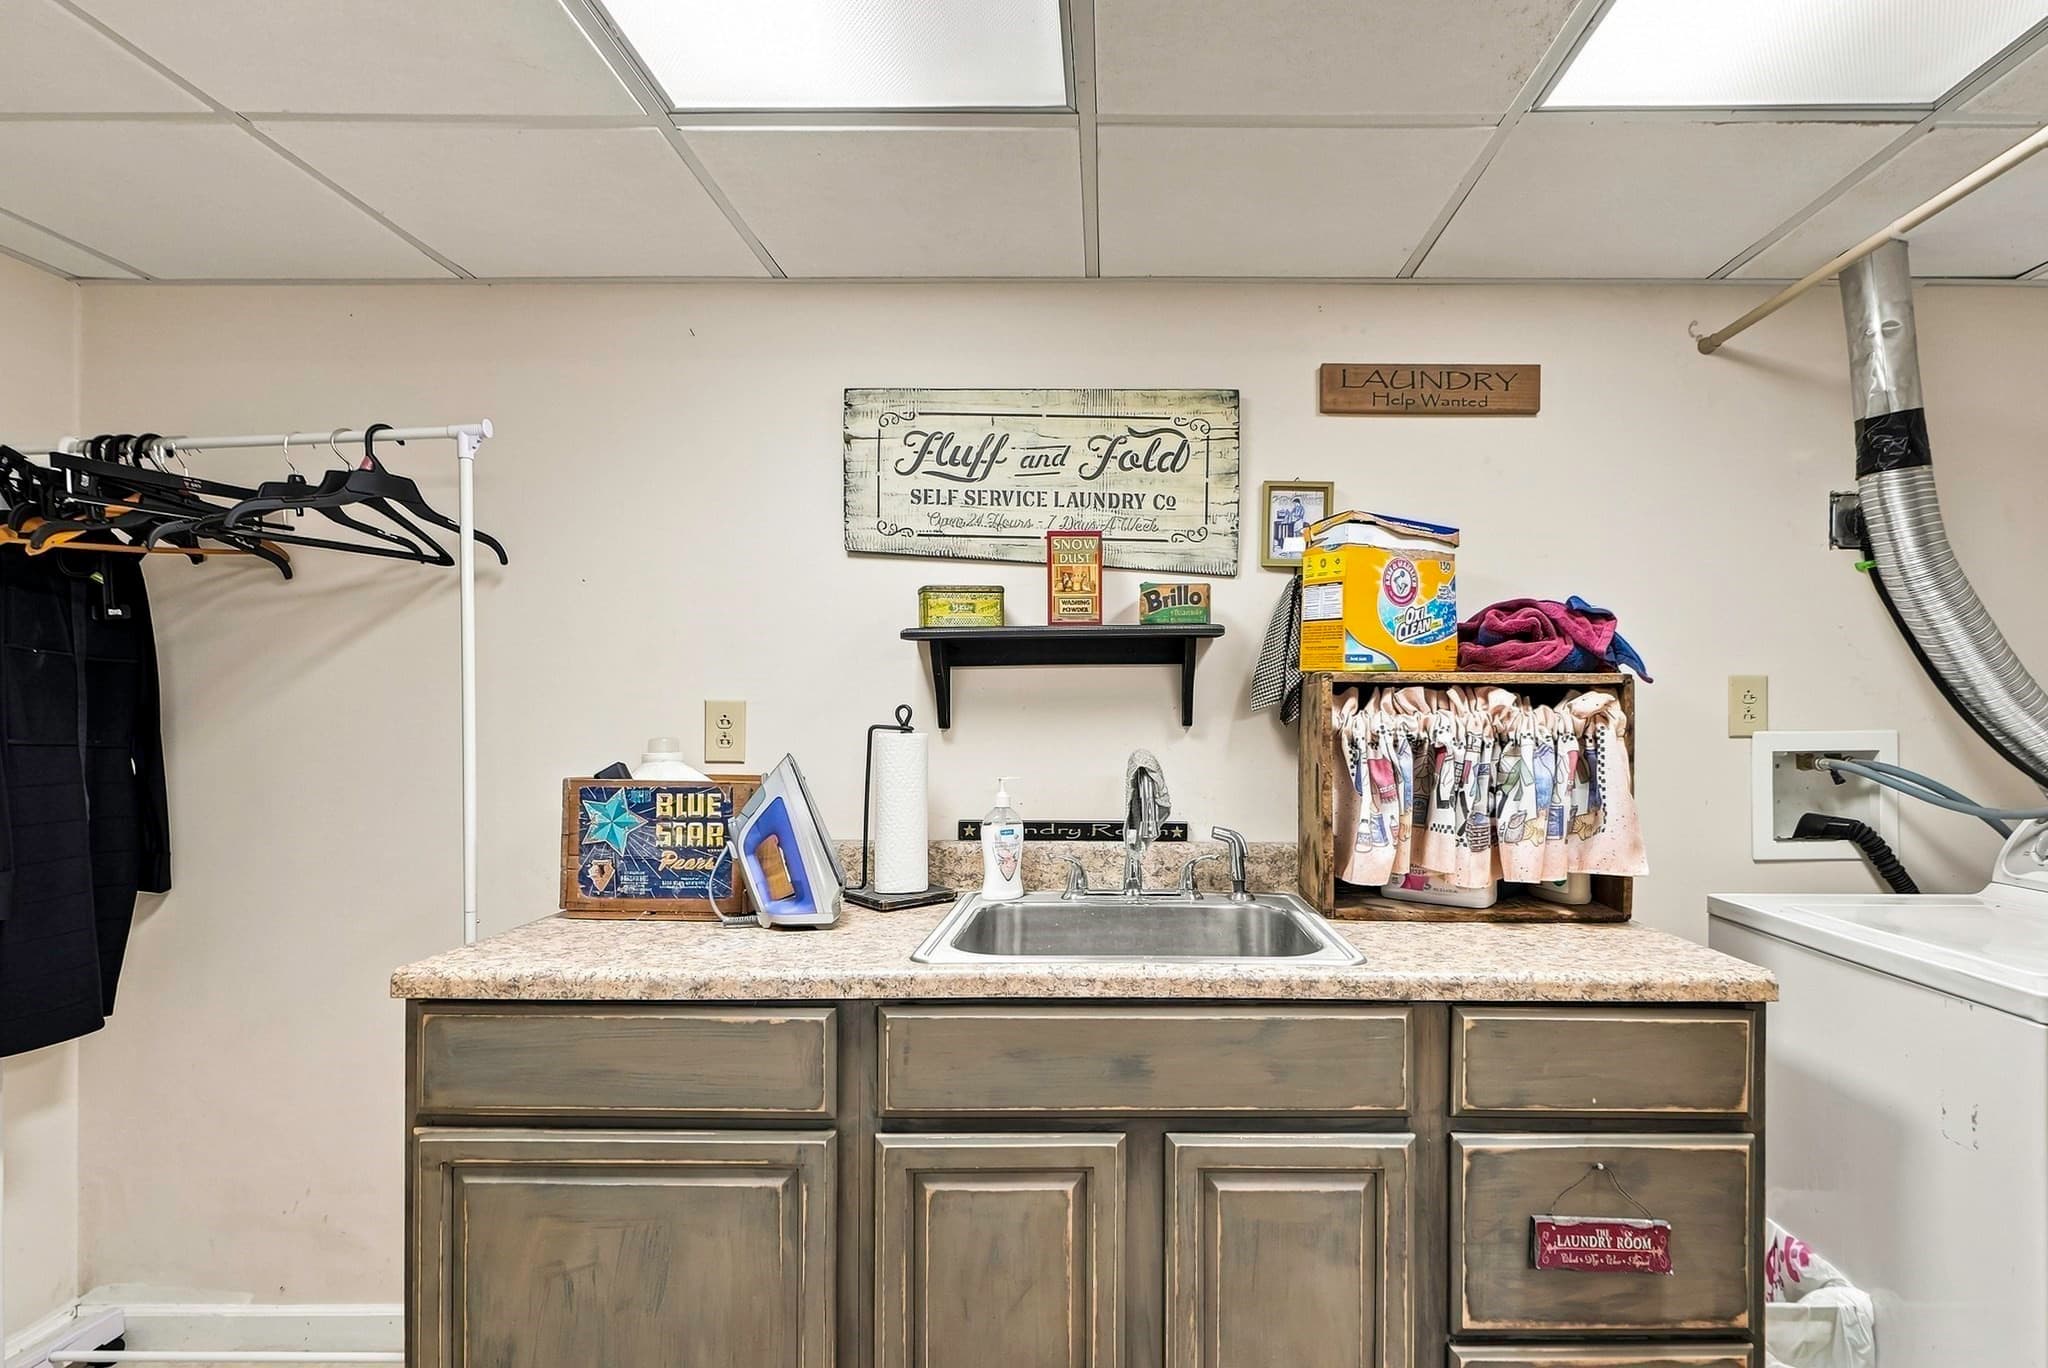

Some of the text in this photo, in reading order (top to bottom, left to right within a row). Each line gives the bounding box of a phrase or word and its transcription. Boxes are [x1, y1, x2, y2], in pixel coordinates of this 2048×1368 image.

[1341, 369, 1519, 392] LAUNDRY
[1372, 391, 1488, 411] Help Wanted
[894, 427, 1191, 482] Fluff and Fold
[910, 488, 957, 506] SELF
[964, 489, 1047, 509] SERVICE
[1054, 490, 1146, 510] LAUNDRY
[928, 512, 964, 529] Open
[967, 513, 985, 527] 24
[987, 512, 1034, 532] Hours
[1048, 515, 1057, 529] 7
[1060, 515, 1097, 531] Days
[1119, 516, 1159, 533] Week
[1053, 538, 1097, 550] SNOW
[1060, 553, 1090, 564] DUST
[1143, 585, 1202, 613] Brillo
[1405, 607, 1425, 624] OXI
[1397, 618, 1432, 641] CLEAN
[656, 793, 721, 818] BLUE
[656, 822, 724, 847] STAR
[1024, 823, 1082, 840] ndry
[658, 850, 716, 871] Pears
[1557, 1234, 1652, 1250] LAUNDRY ROOM
